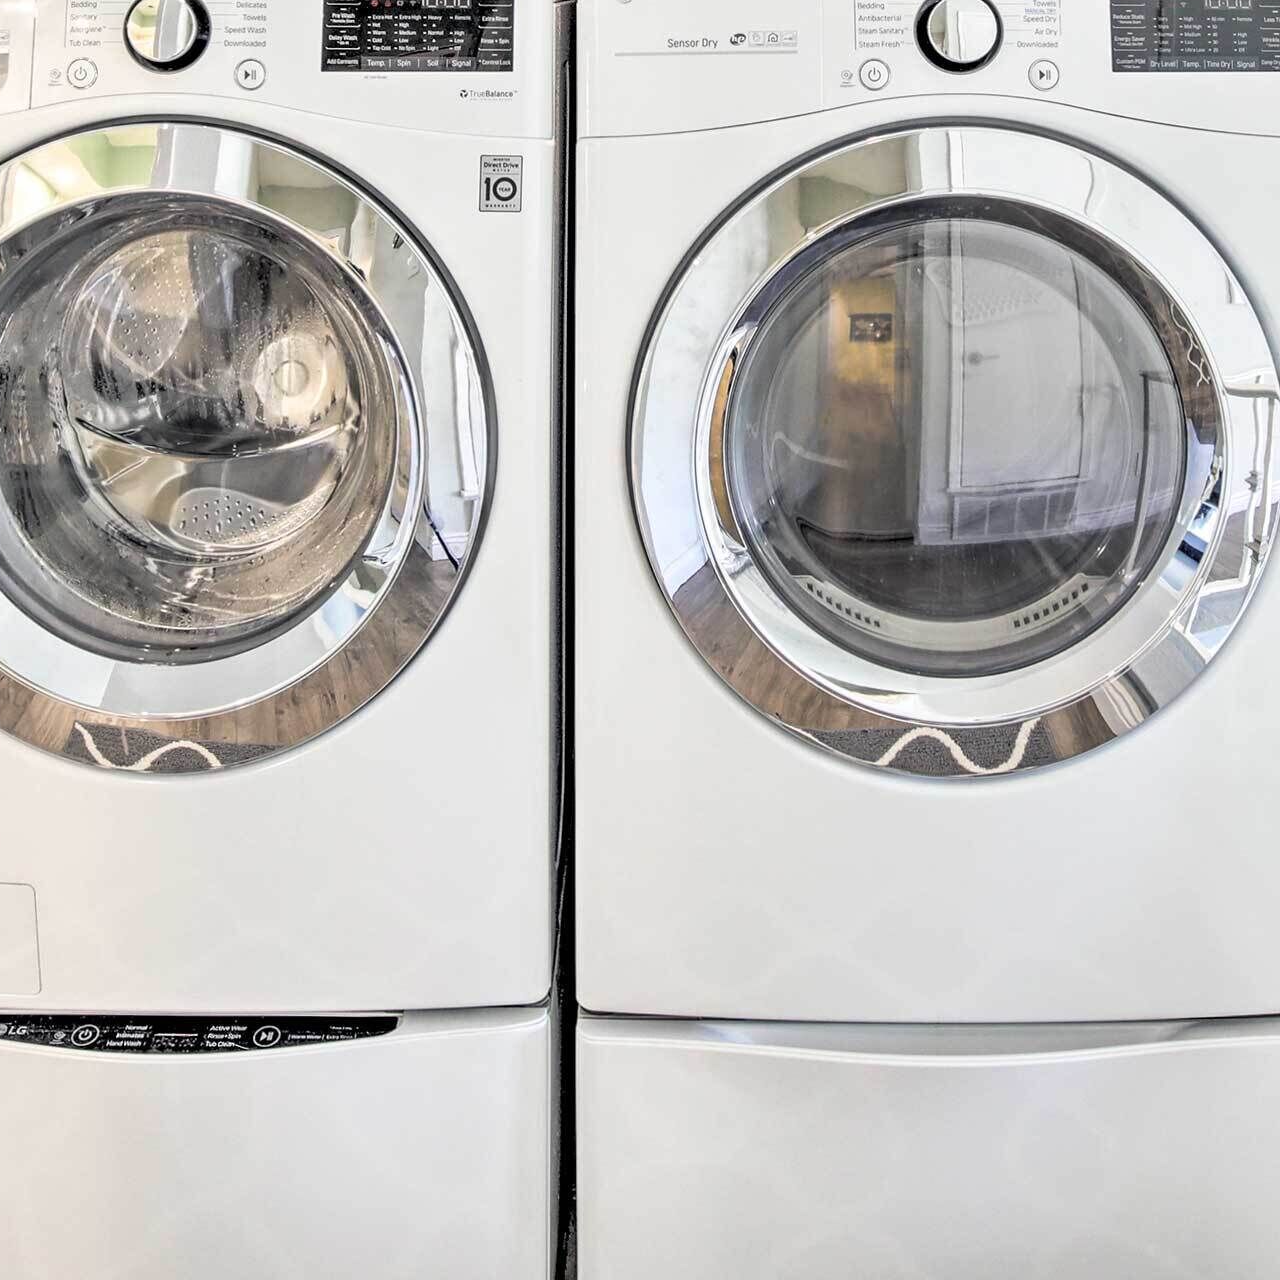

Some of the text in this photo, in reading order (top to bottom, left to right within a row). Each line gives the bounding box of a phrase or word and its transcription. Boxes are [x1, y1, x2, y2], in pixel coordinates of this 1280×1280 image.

[857, 2, 885, 10] Bedding
[224, 26, 246, 34] Speed
[879, 27, 904, 35] Sanitary
[1045, 28, 1057, 36] Dry
[82, 39, 101, 47] Clean
[223, 39, 266, 47] Downloaded
[667, 38, 718, 49] Sensor Dry
[367, 59, 385, 67] Temp.
[397, 59, 412, 68] Spin
[427, 59, 439, 67] Soil
[451, 59, 472, 68] Signal
[1150, 60, 1160, 68] Dry
[1182, 60, 1200, 68] Temp.
[1220, 60, 1231, 68] Dry
[484, 177, 517, 202] 10
[8, 1025, 28, 1035] LG
